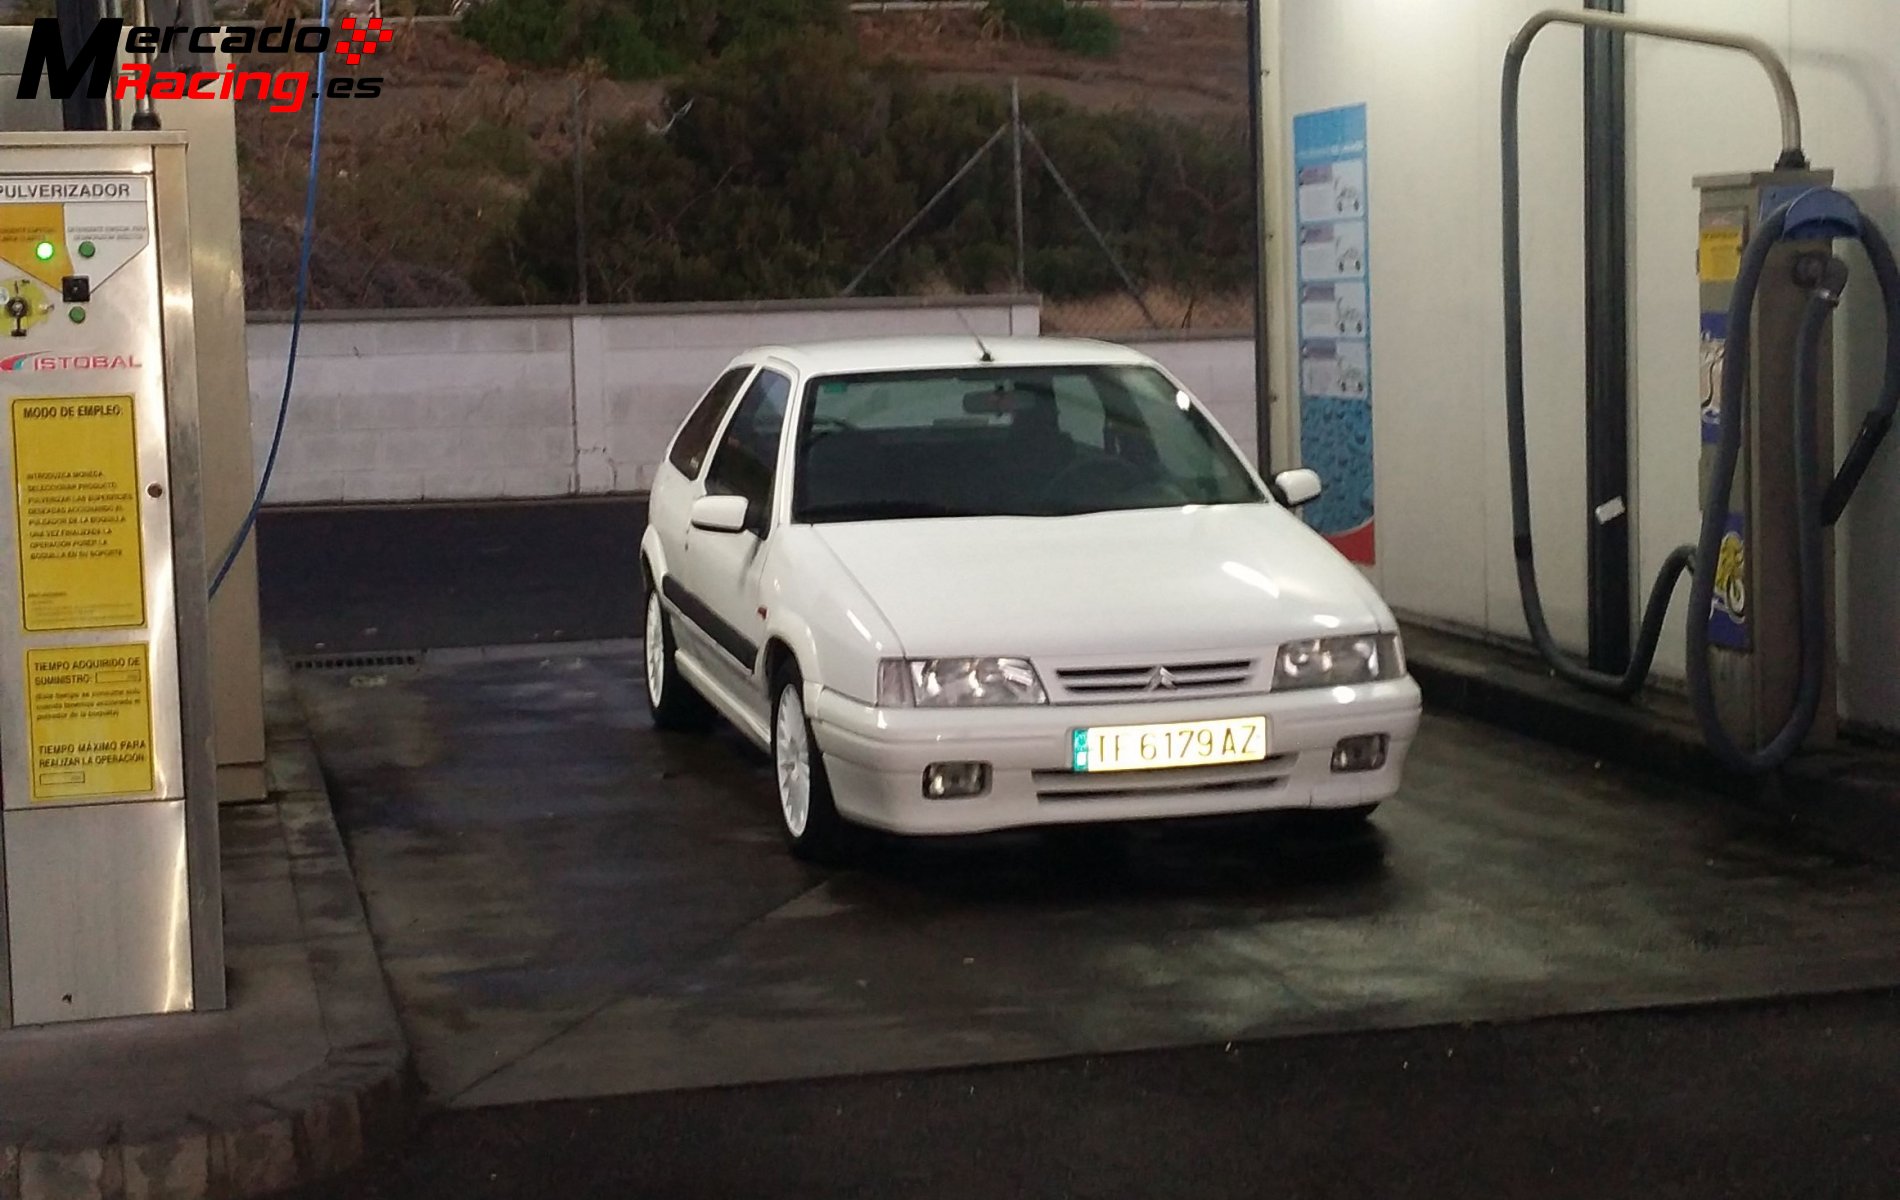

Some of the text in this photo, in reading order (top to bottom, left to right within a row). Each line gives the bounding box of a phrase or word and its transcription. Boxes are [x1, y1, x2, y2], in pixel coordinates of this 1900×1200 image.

[34, 355, 142, 371] ISTOBAL
[23, 406, 57, 419] MODO
[61, 406, 76, 417] DE
[34, 656, 141, 671] TIEMPO ADQUIRIDO DE
[39, 743, 75, 755] TIEMPO
[119, 739, 146, 750] PARA
[1140, 728, 1213, 761] 6179
[1221, 725, 1256, 755] AZ
[39, 757, 80, 768] REALIZAR
[82, 757, 93, 766] LA
